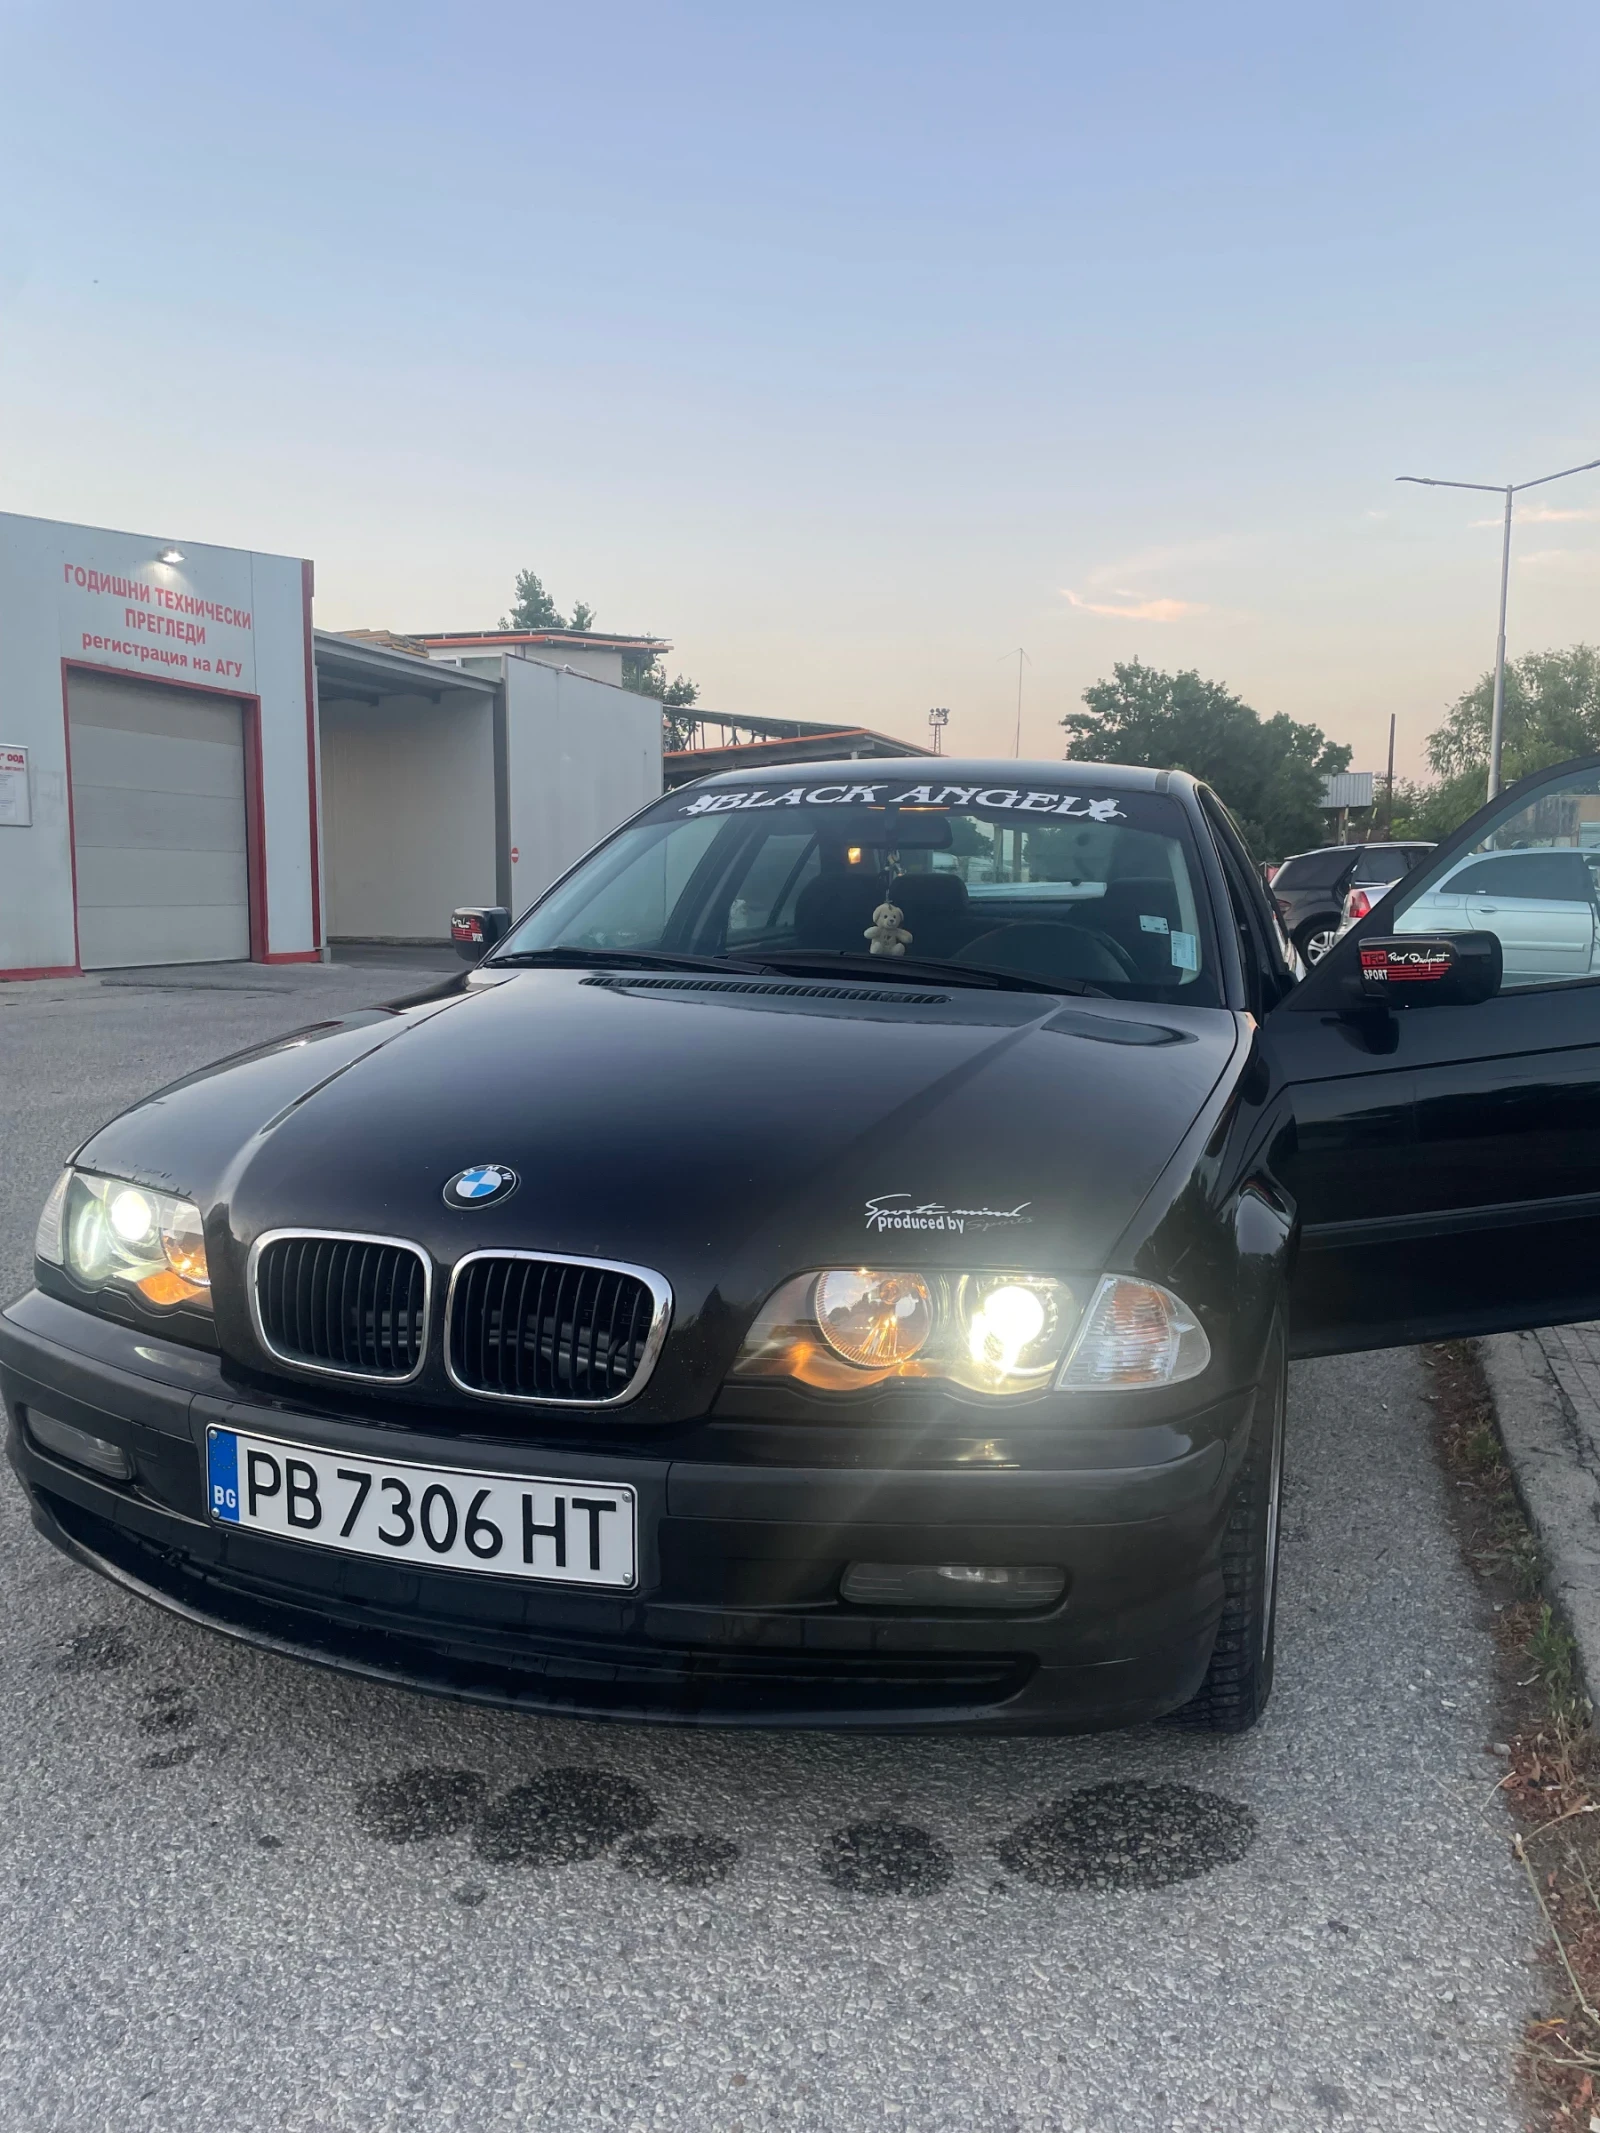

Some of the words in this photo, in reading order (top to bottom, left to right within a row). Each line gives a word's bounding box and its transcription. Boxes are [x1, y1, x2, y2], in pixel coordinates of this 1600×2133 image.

[64, 563, 150, 604] ГОДИШНИ
[154, 587, 251, 630] ТЕХНИЧЕСКИ
[125, 608, 206, 645] ПРЕГЛЕДИ
[82, 632, 188, 668] регистрация
[193, 657, 211, 672] на
[215, 659, 243, 678] АГУ
[701, 785, 888, 813] BLACK
[889, 785, 1092, 817] ANGEL
[1363, 969, 1388, 981] SPORT
[877, 1215, 945, 1232] produced
[948, 1216, 964, 1234] by
[213, 1484, 236, 1508] BG
[246, 1448, 322, 1530] PB
[336, 1468, 504, 1560] 7306
[521, 1493, 618, 1571] HT
